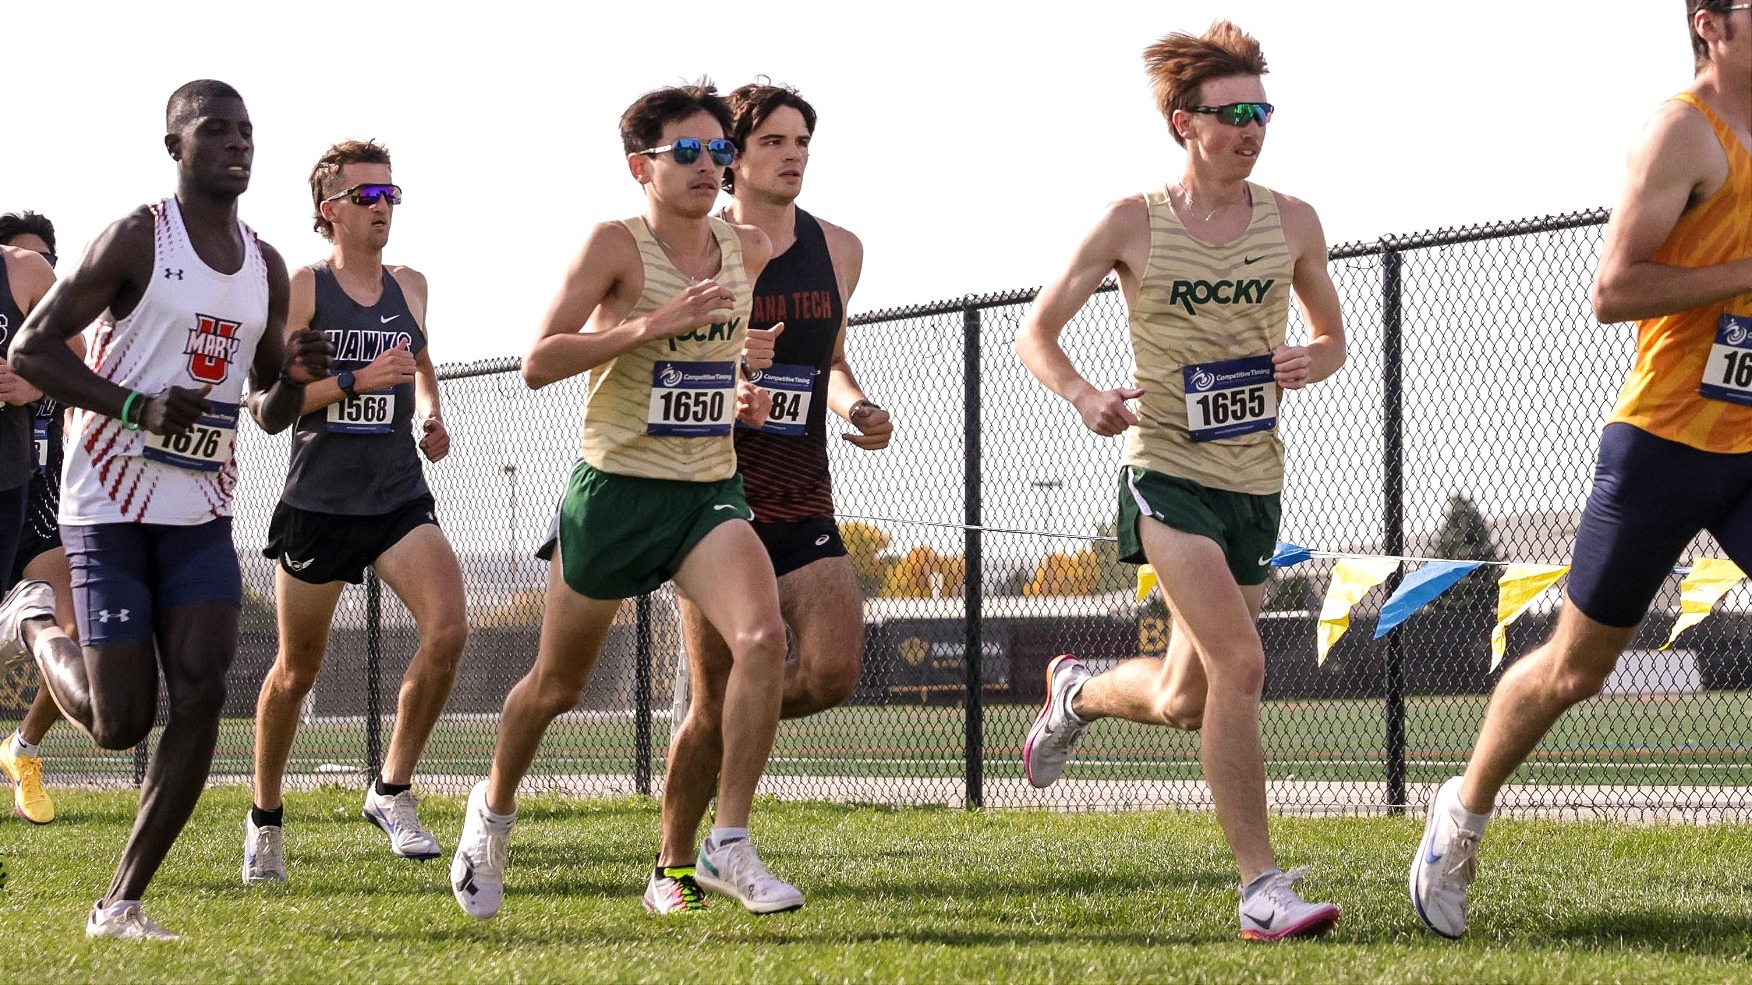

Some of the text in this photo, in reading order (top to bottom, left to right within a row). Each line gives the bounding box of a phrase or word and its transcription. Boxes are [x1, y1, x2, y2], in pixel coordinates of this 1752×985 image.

[792, 291, 832, 320] TECH
[1170, 279, 1274, 315] ROCKY
[184, 328, 240, 363] MARY
[669, 317, 741, 351] CKY
[338, 396, 387, 422] 1568
[660, 391, 724, 422] 1650
[768, 391, 801, 421] 84
[1196, 387, 1265, 426] 1655
